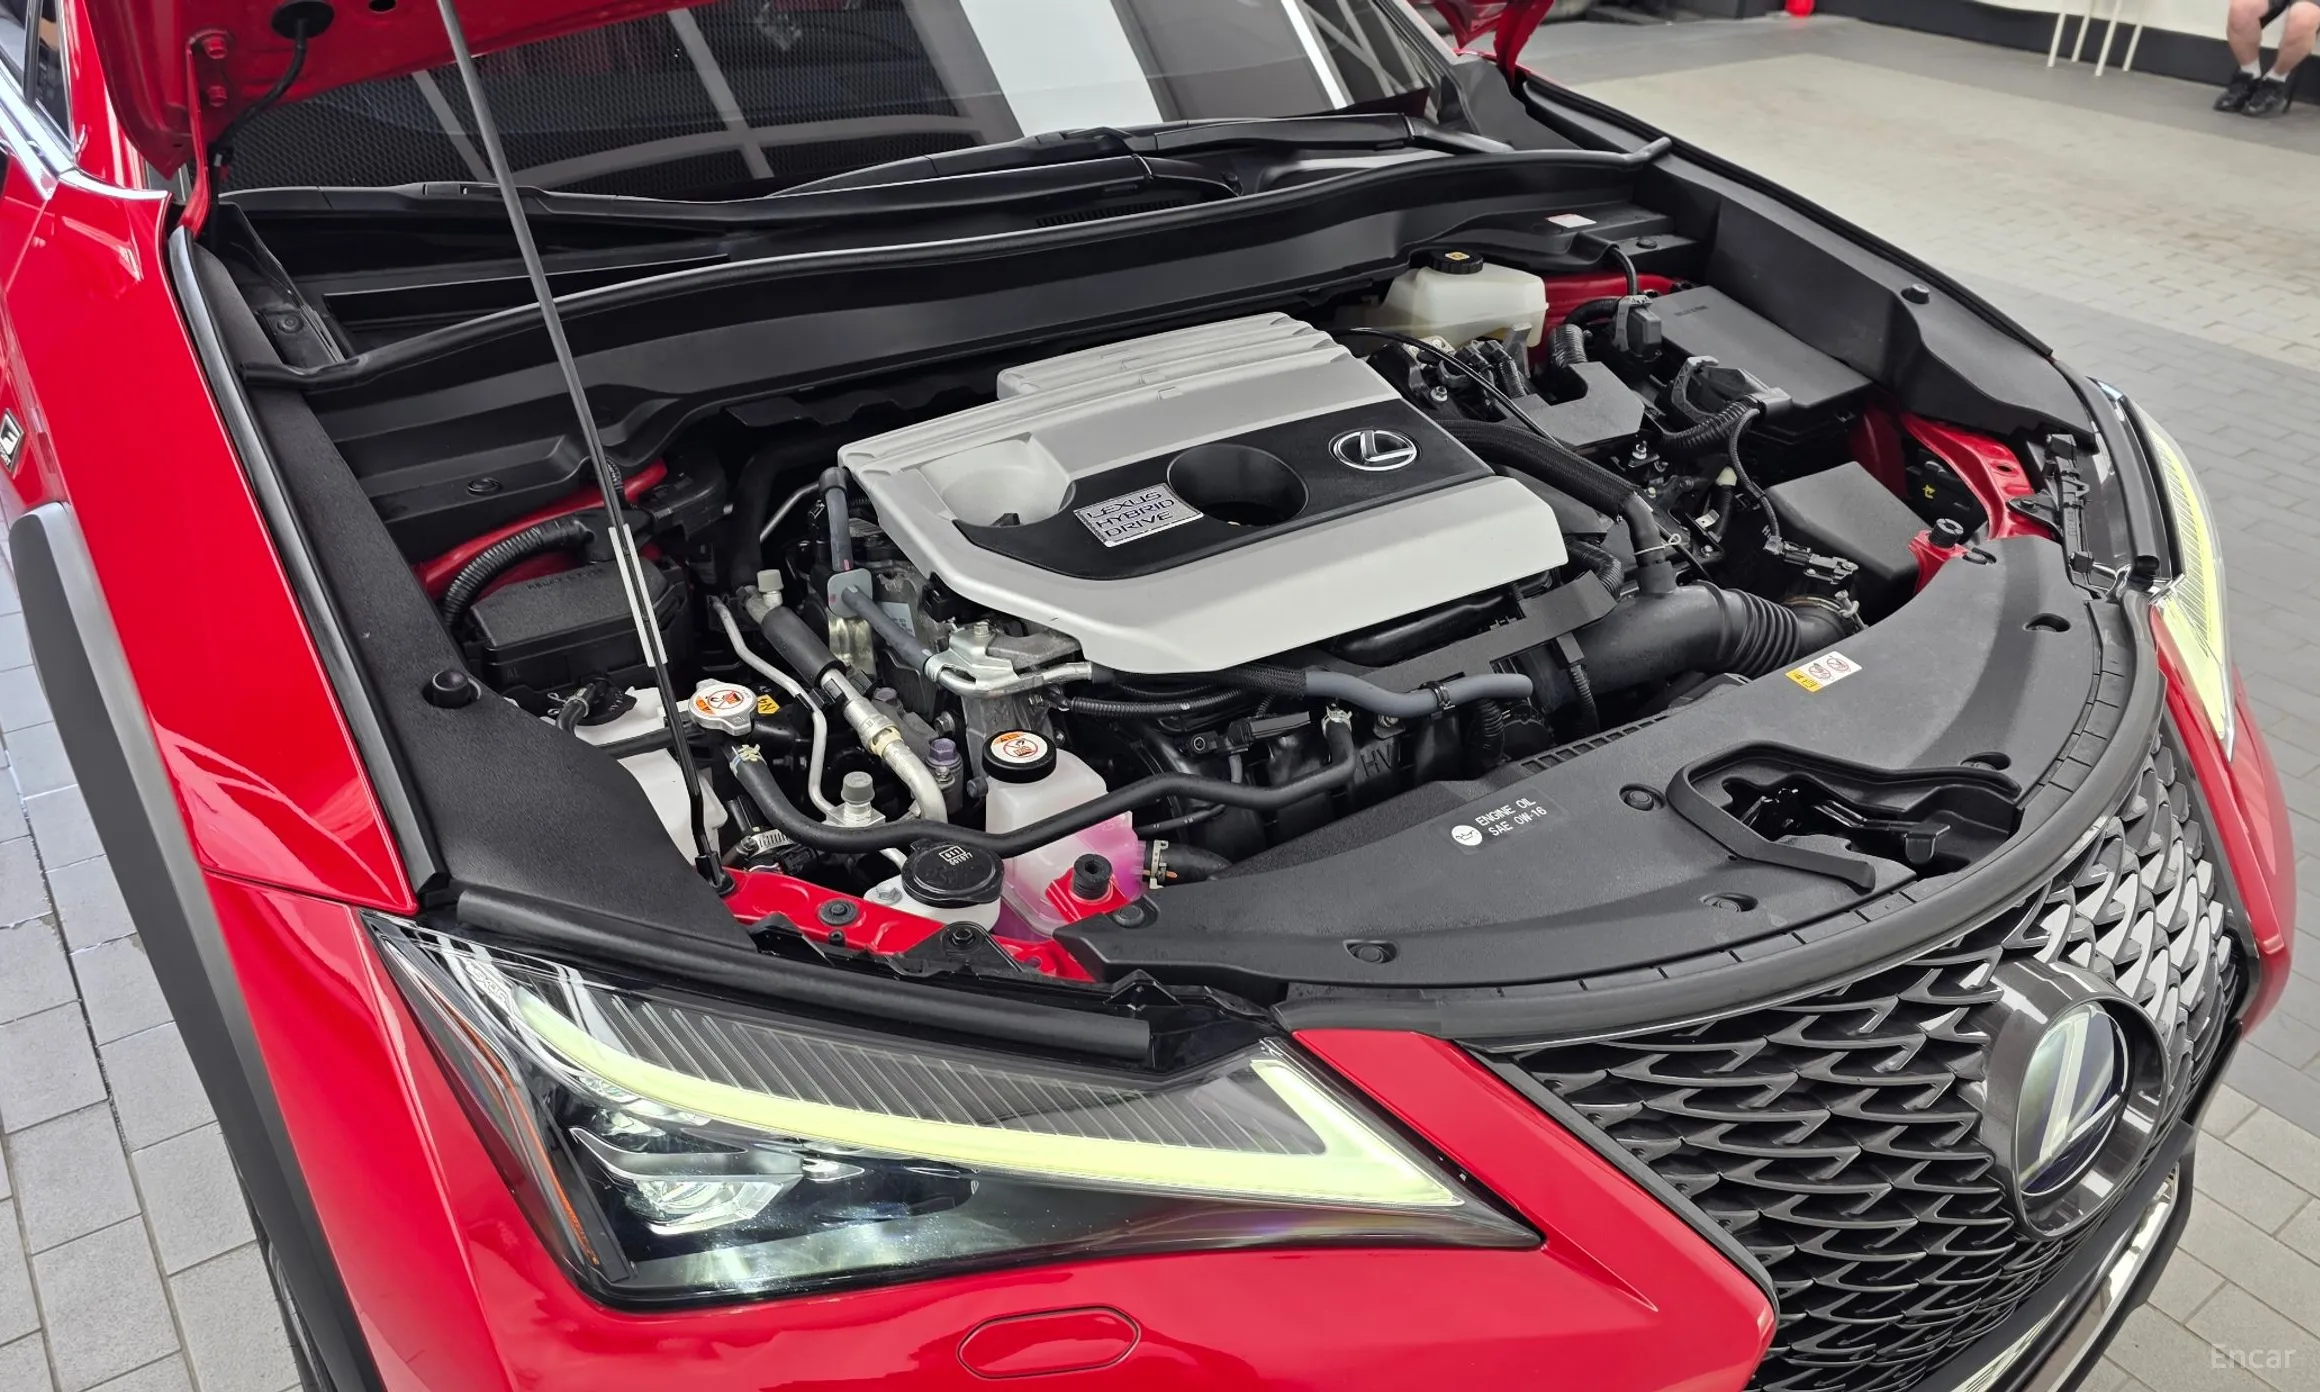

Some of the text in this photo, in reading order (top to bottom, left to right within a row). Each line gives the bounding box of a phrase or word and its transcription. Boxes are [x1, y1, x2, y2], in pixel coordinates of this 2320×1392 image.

[1087, 491, 1161, 518] LEXUS
[1096, 499, 1175, 528] HYBRID
[1104, 511, 1173, 537] DRIVE
[1360, 744, 1391, 777] HV
[1475, 798, 1537, 826] ENGINE OIL
[1488, 806, 1547, 836] SAE 0W-16
